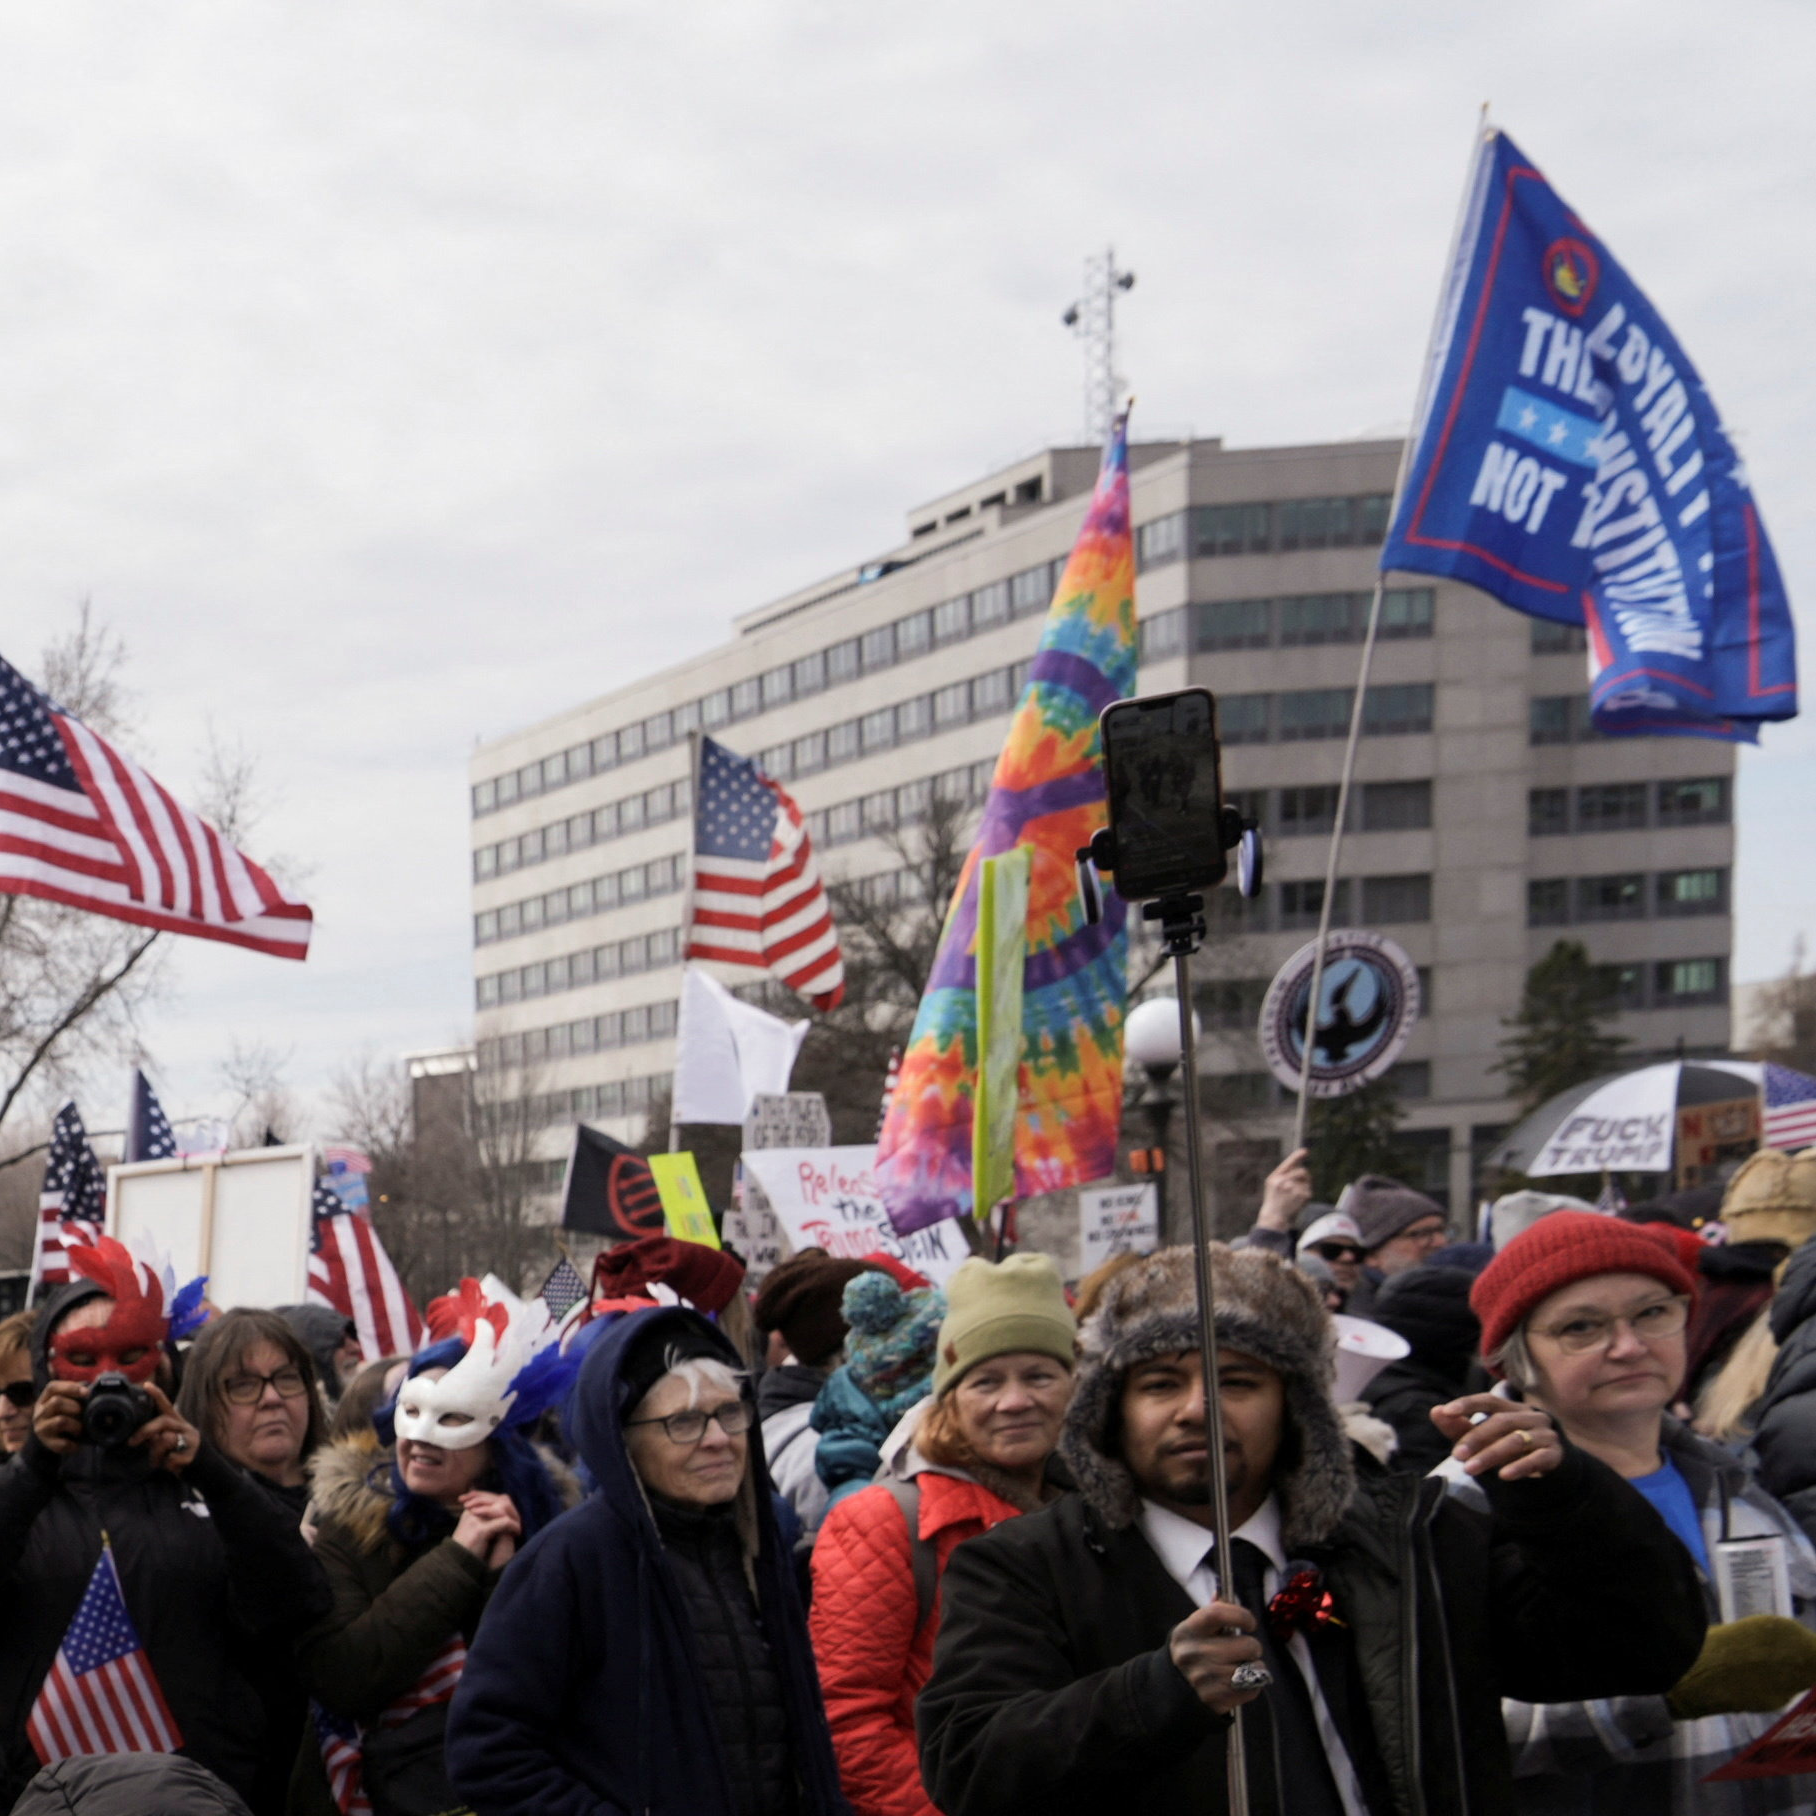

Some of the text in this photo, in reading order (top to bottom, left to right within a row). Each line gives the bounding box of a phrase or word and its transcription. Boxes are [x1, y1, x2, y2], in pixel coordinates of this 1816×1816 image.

[1470, 442, 1567, 535] NOT
[1558, 1114, 1667, 1142] FUCK
[1550, 1142, 1664, 1168] TRUMP
